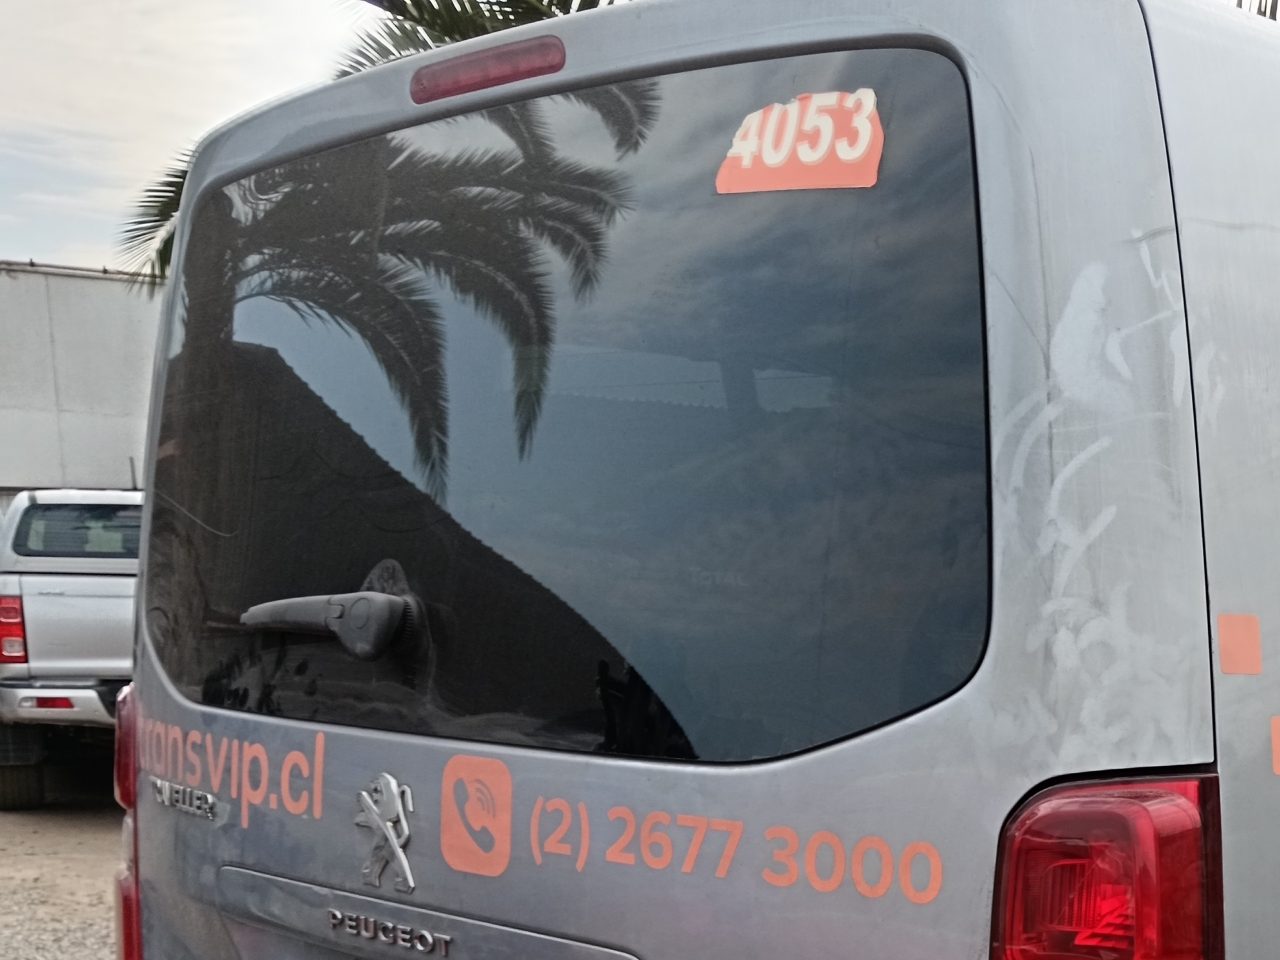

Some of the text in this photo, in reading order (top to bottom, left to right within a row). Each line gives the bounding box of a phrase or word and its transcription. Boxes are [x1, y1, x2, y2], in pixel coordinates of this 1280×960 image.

[726, 87, 878, 168] 4053
[530, 795, 944, 905] (2) 2677 3000
[327, 907, 453, 957] PEUGEOT
